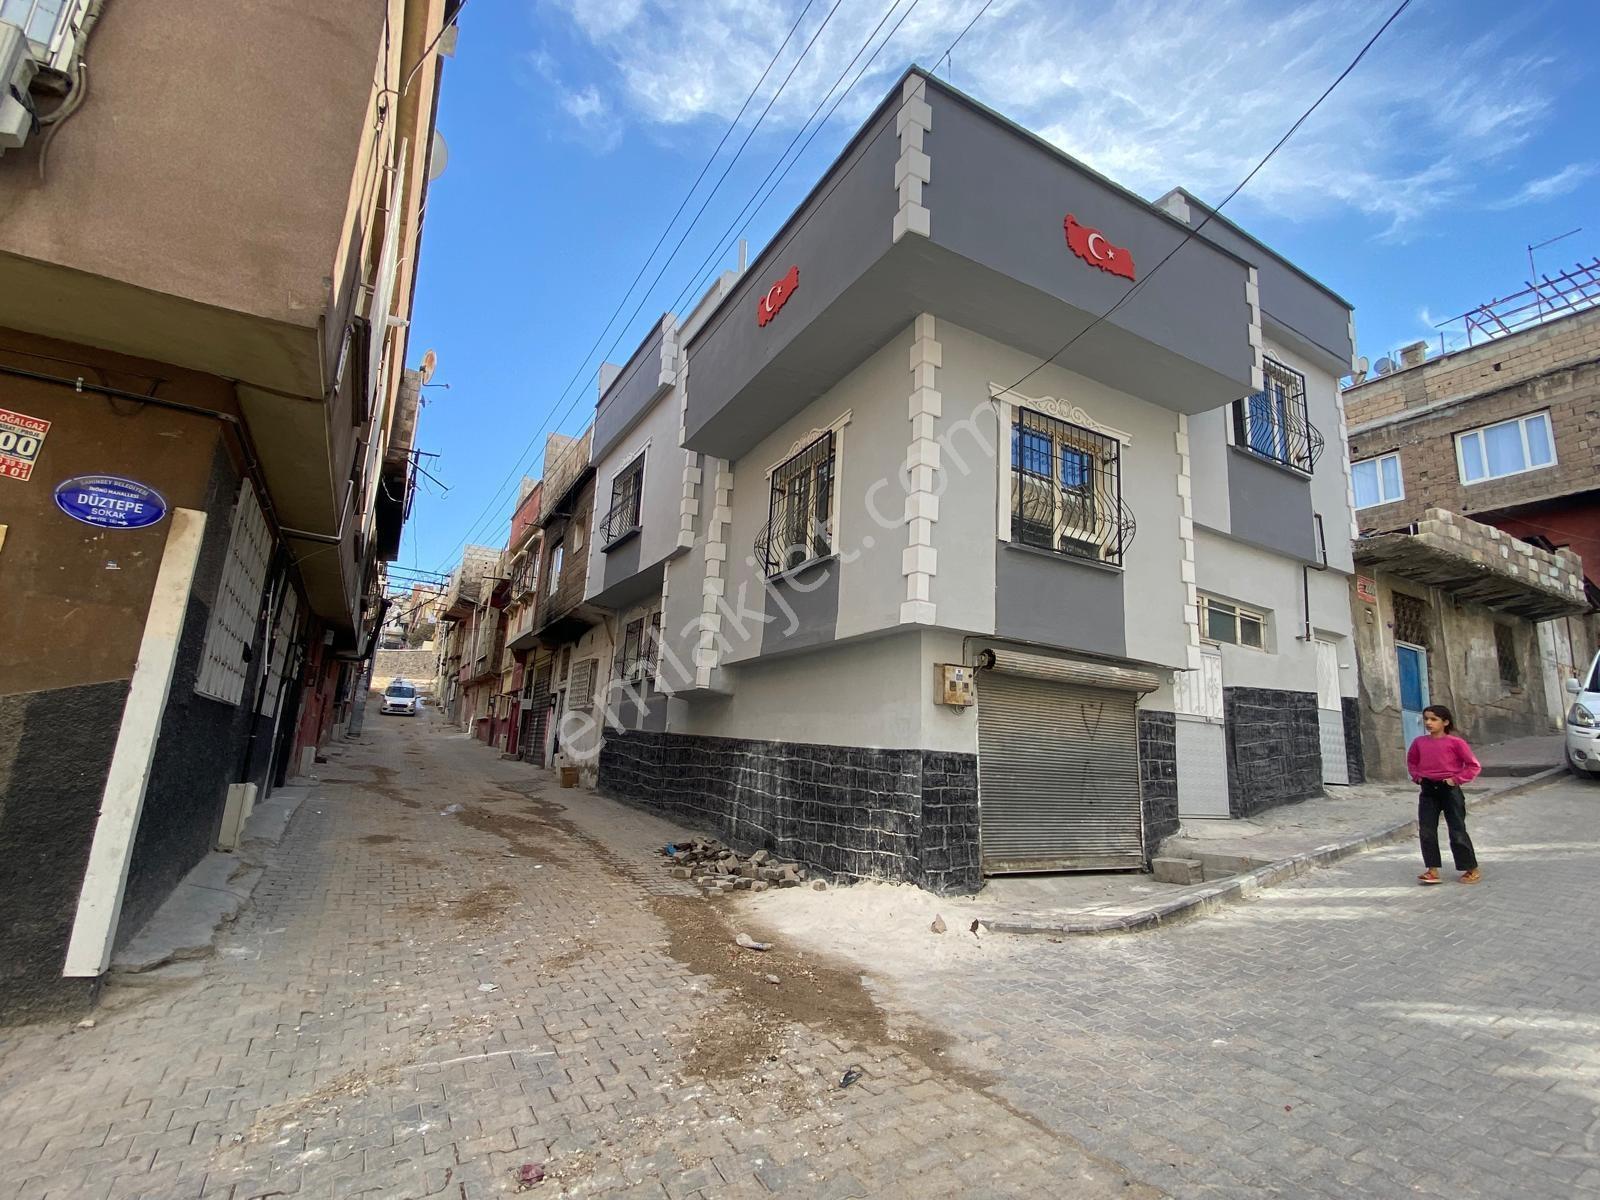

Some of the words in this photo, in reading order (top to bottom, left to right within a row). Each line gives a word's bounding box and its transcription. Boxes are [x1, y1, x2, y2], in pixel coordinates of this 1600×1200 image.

[108, 489, 139, 499] MAHALLESİ
[77, 493, 144, 514] DÜZTEPE
[91, 507, 126, 519] SOKAK
